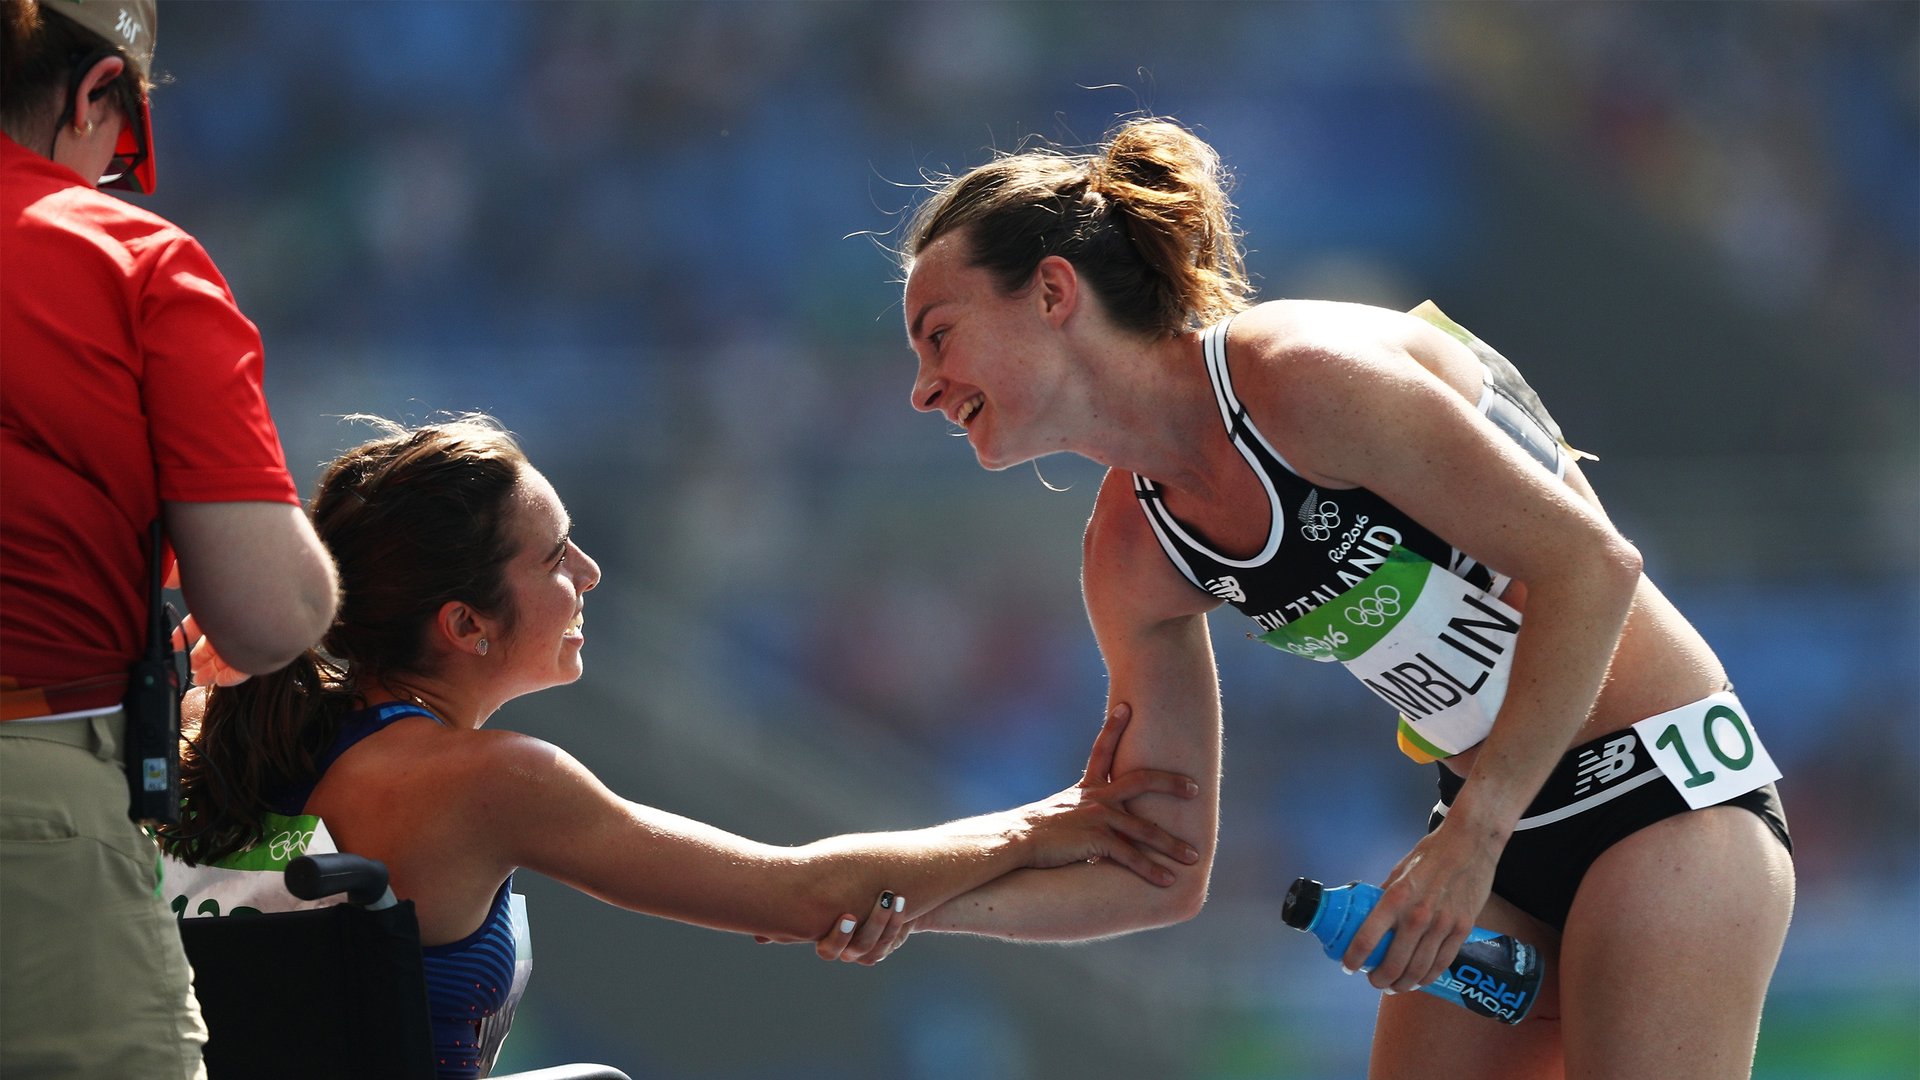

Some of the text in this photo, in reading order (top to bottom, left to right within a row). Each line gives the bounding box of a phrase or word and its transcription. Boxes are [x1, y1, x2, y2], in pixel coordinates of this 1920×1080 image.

[1327, 513, 1370, 564] Rio2016
[1252, 609, 1288, 632] EW
[1363, 593, 1521, 721] MBLIN
[1655, 704, 1754, 789] 10
[1455, 964, 1527, 1010] PRO
